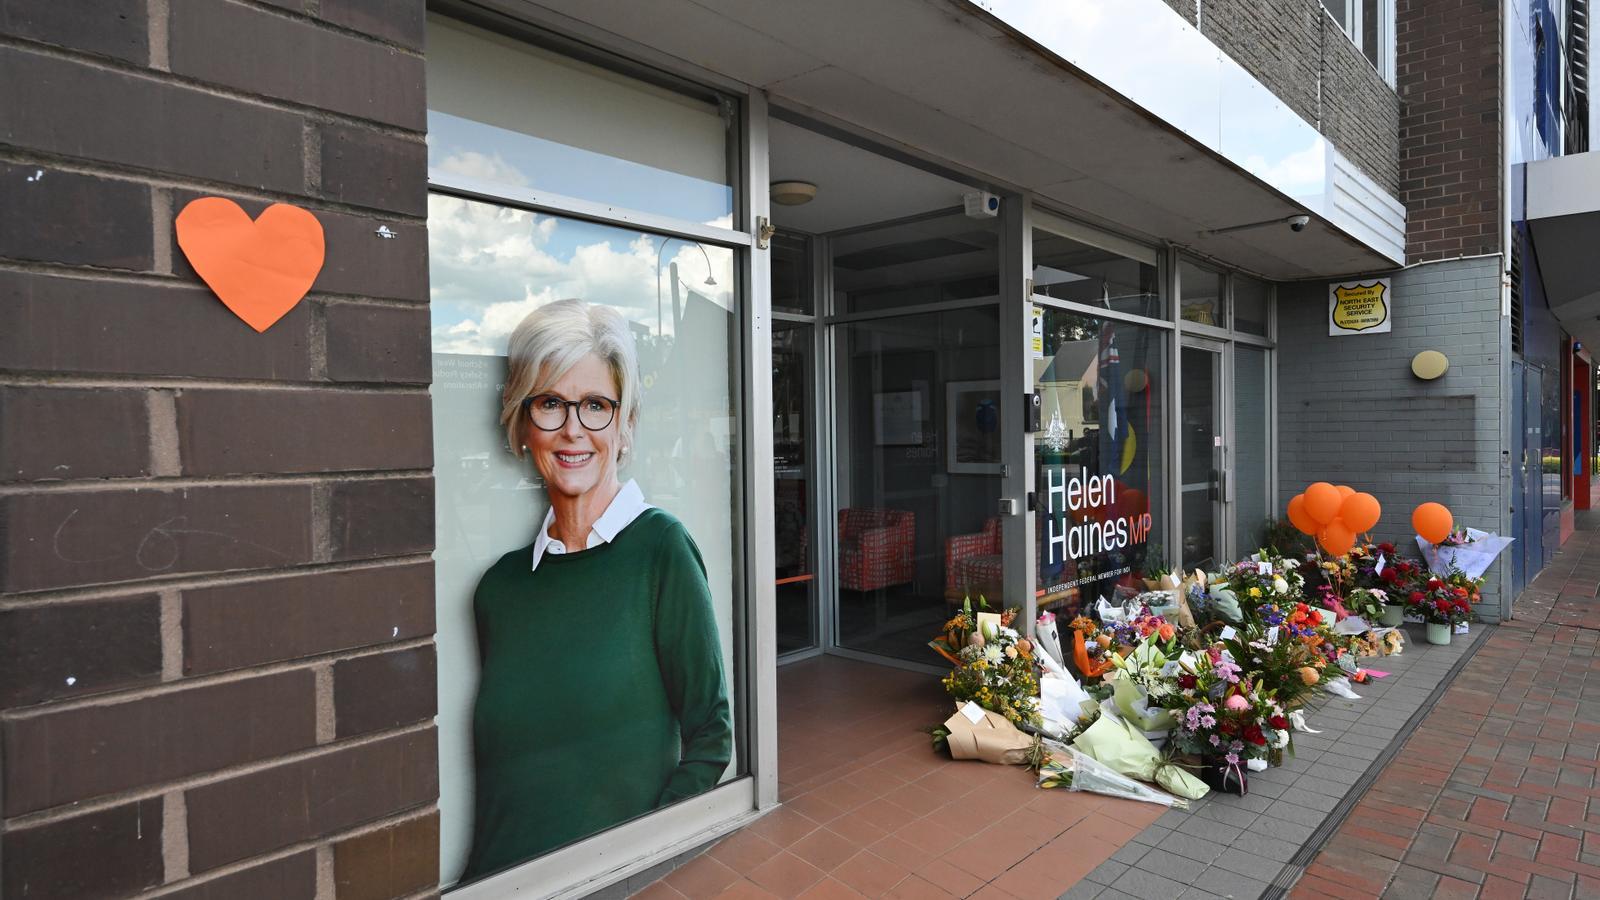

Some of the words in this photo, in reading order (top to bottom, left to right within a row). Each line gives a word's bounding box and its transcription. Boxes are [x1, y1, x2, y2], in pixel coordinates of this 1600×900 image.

[1048, 466, 1114, 514] Helen
[1048, 515, 1128, 564] Haines
[1130, 512, 1152, 546] MP
[1048, 580, 1078, 594] INDEPENDENT
[1079, 576, 1098, 584] FEDERAL
[1098, 569, 1114, 580] MEMBER
